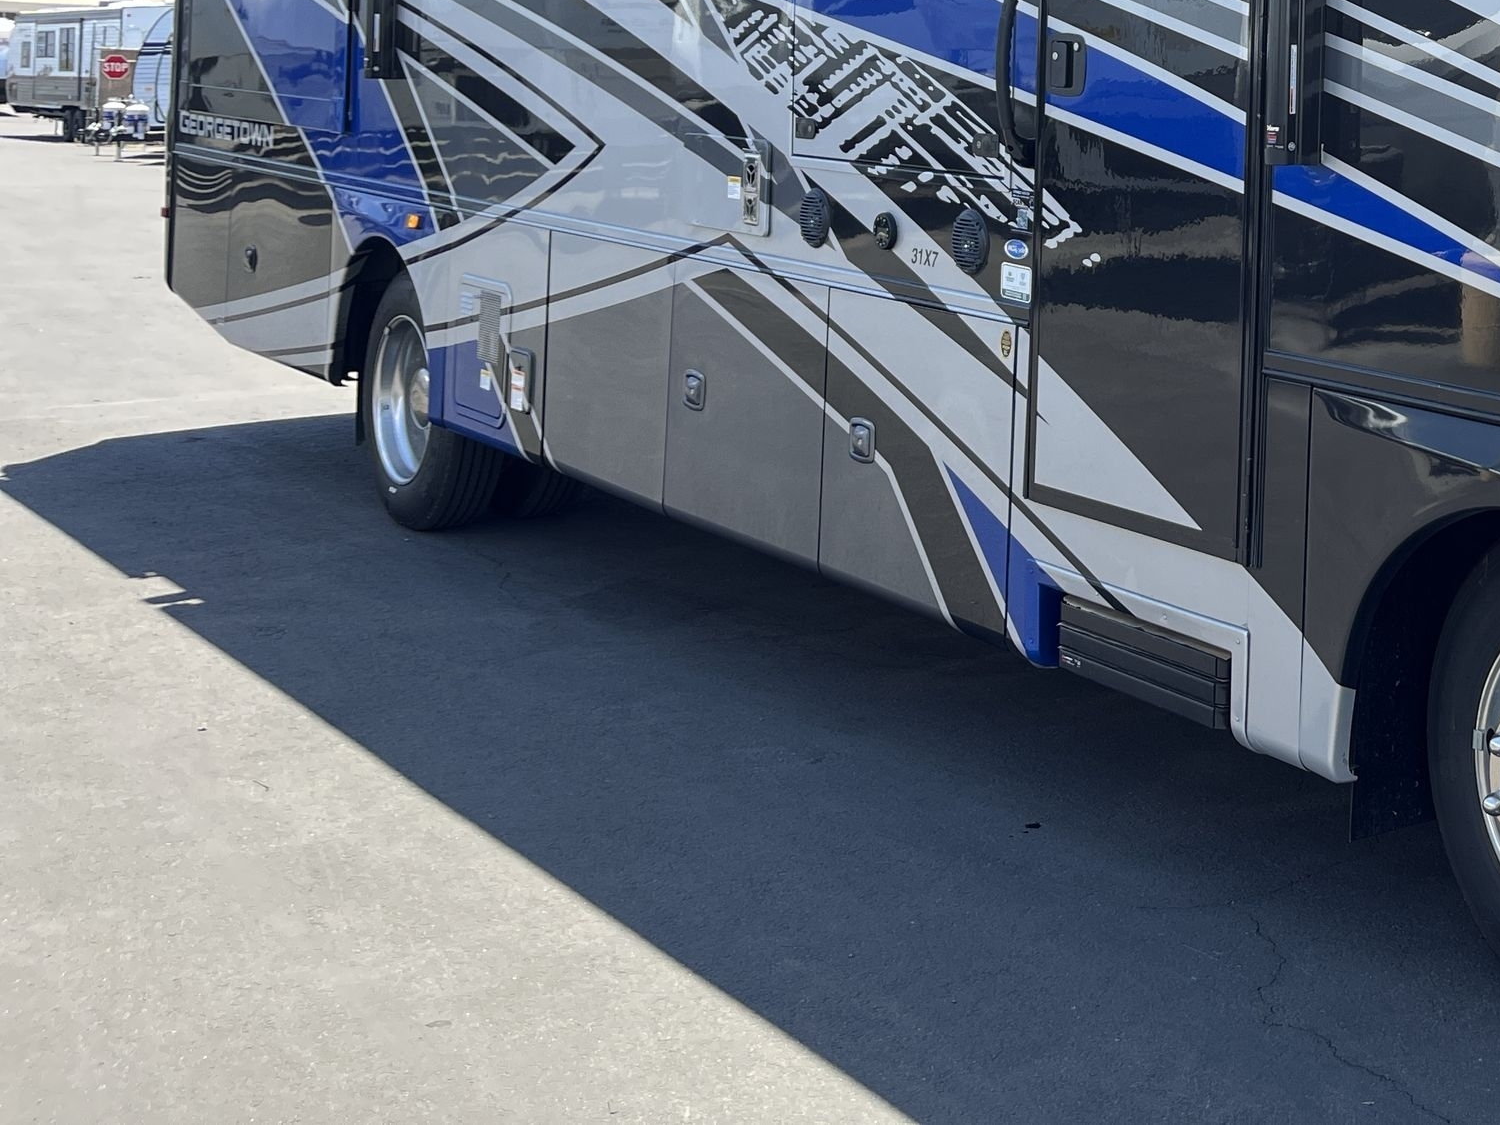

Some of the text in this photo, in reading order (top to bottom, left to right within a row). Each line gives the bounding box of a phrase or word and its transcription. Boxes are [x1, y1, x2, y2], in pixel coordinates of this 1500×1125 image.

[103, 62, 129, 73] STOP
[179, 109, 275, 148] GEORGETOWN
[911, 247, 939, 268] 31X7
